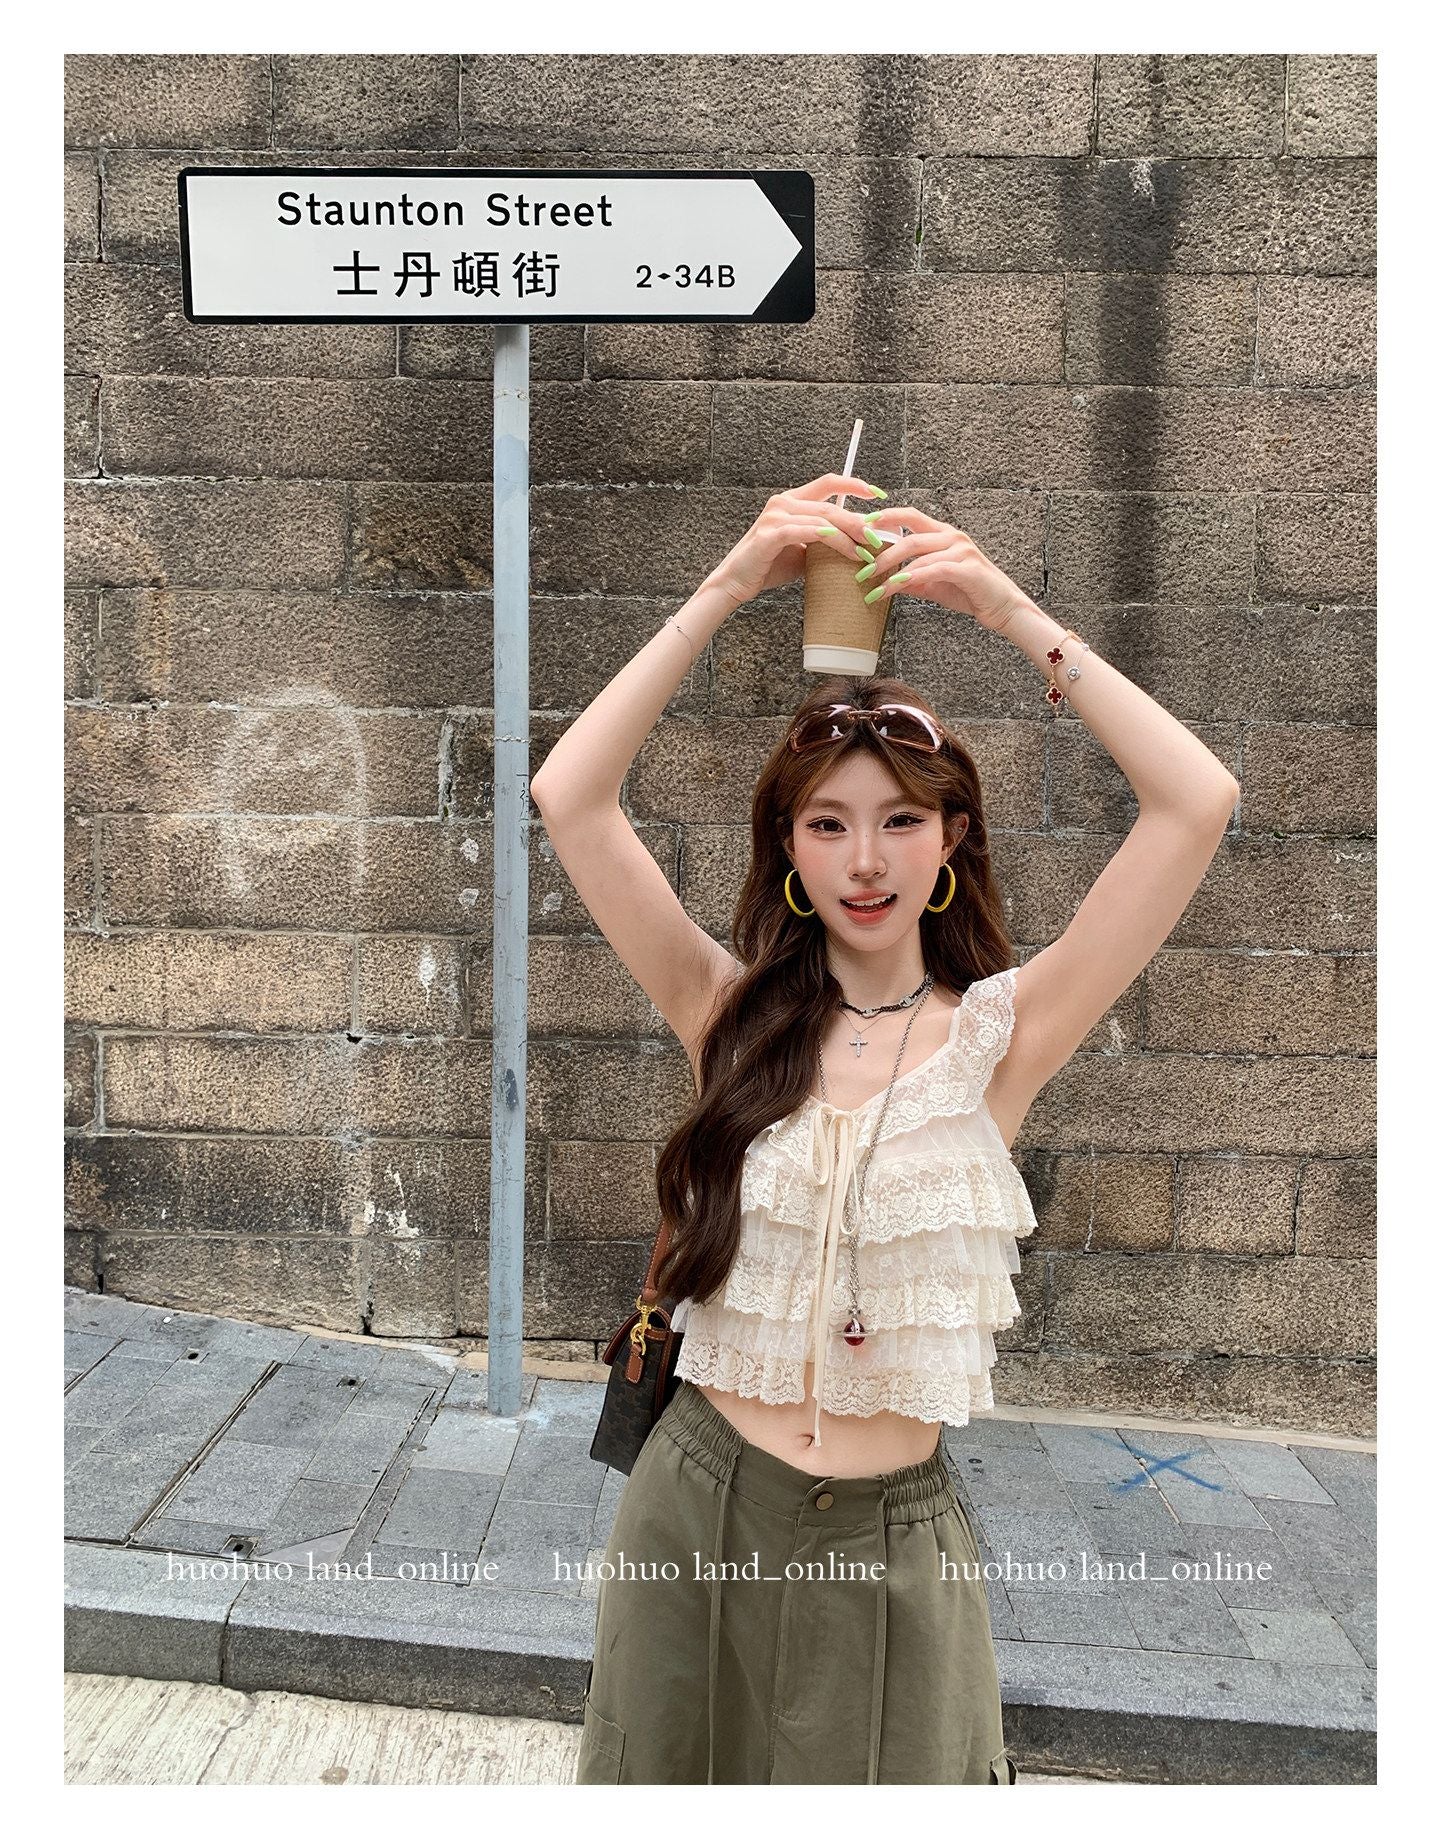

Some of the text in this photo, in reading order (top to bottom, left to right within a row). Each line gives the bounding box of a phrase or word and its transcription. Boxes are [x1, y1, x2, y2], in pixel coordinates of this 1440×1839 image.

[277, 191, 613, 227] Staunton Street
[333, 250, 560, 298] 士丹頓街
